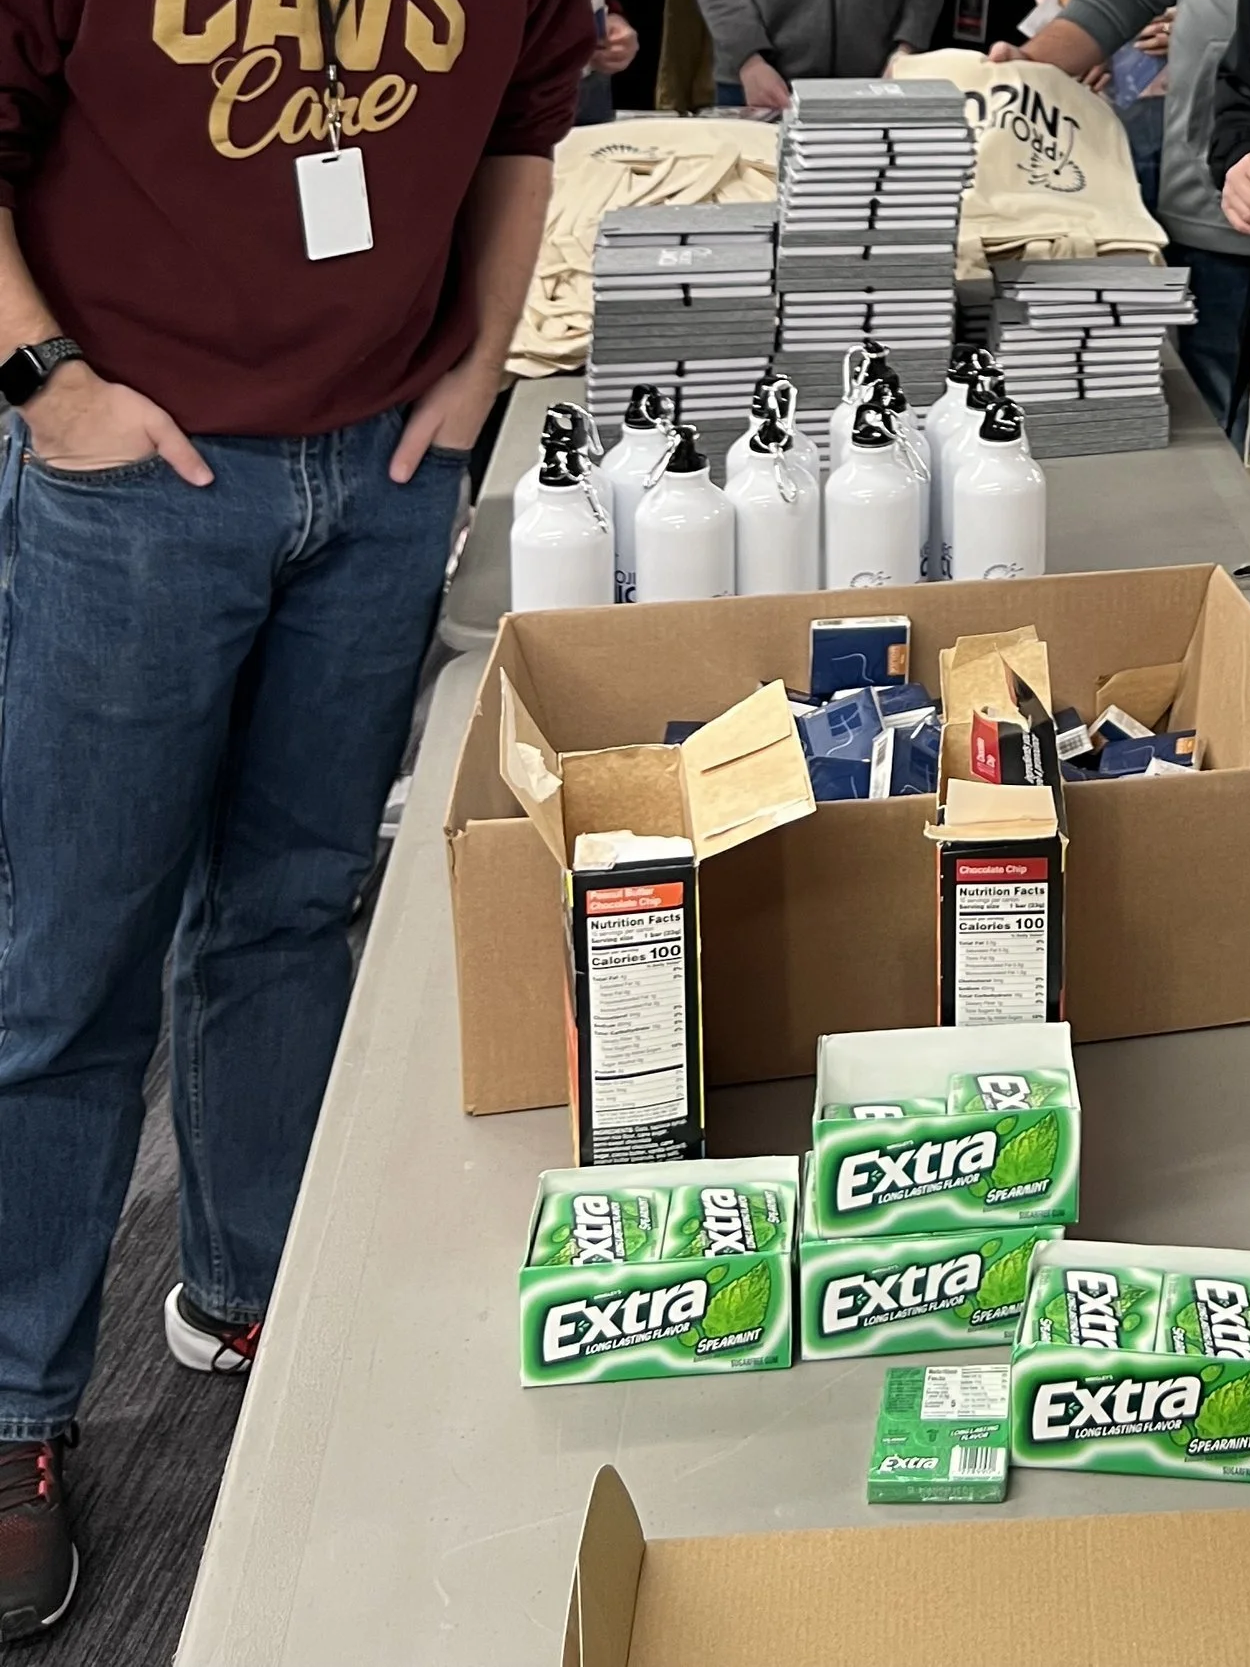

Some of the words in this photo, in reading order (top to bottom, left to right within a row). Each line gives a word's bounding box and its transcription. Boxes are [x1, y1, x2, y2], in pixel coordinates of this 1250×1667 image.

[208, 48, 418, 159] Care
[1005, 864, 1027, 875] Chip
[959, 887, 1010, 897] Nutrition
[1014, 886, 1045, 896] Facts
[591, 917, 645, 930] Nutrition
[648, 913, 681, 925] Facts
[959, 921, 1011, 931] Calories
[1015, 918, 1045, 929] 100
[591, 952, 647, 967] Calories
[650, 945, 681, 959] 100
[837, 1130, 997, 1211] Extra
[878, 1191, 905, 1204] LONG
[904, 1182, 944, 1198] LASTING
[943, 1173, 980, 1189] FLAVOR
[986, 1179, 1050, 1203] SPEARMINT
[572, 1194, 624, 1266] xtra
[701, 1188, 754, 1258] xtra
[823, 1253, 982, 1334] Extra
[543, 1279, 708, 1362] Extra
[863, 1313, 889, 1326] LONG
[889, 1304, 928, 1320] LASTING
[928, 1294, 965, 1311] FLAVOR
[585, 1340, 611, 1355] LONG
[612, 1330, 652, 1347] LASTING
[652, 1322, 691, 1339] FLAVOR
[697, 1328, 762, 1353] SPEARMINT
[1032, 1375, 1202, 1440] Extra
[1074, 1426, 1102, 1439] LONG
[1101, 1422, 1143, 1436] LASTING
[1143, 1419, 1183, 1432] FLAVOR
[878, 1455, 940, 1473] Extra
